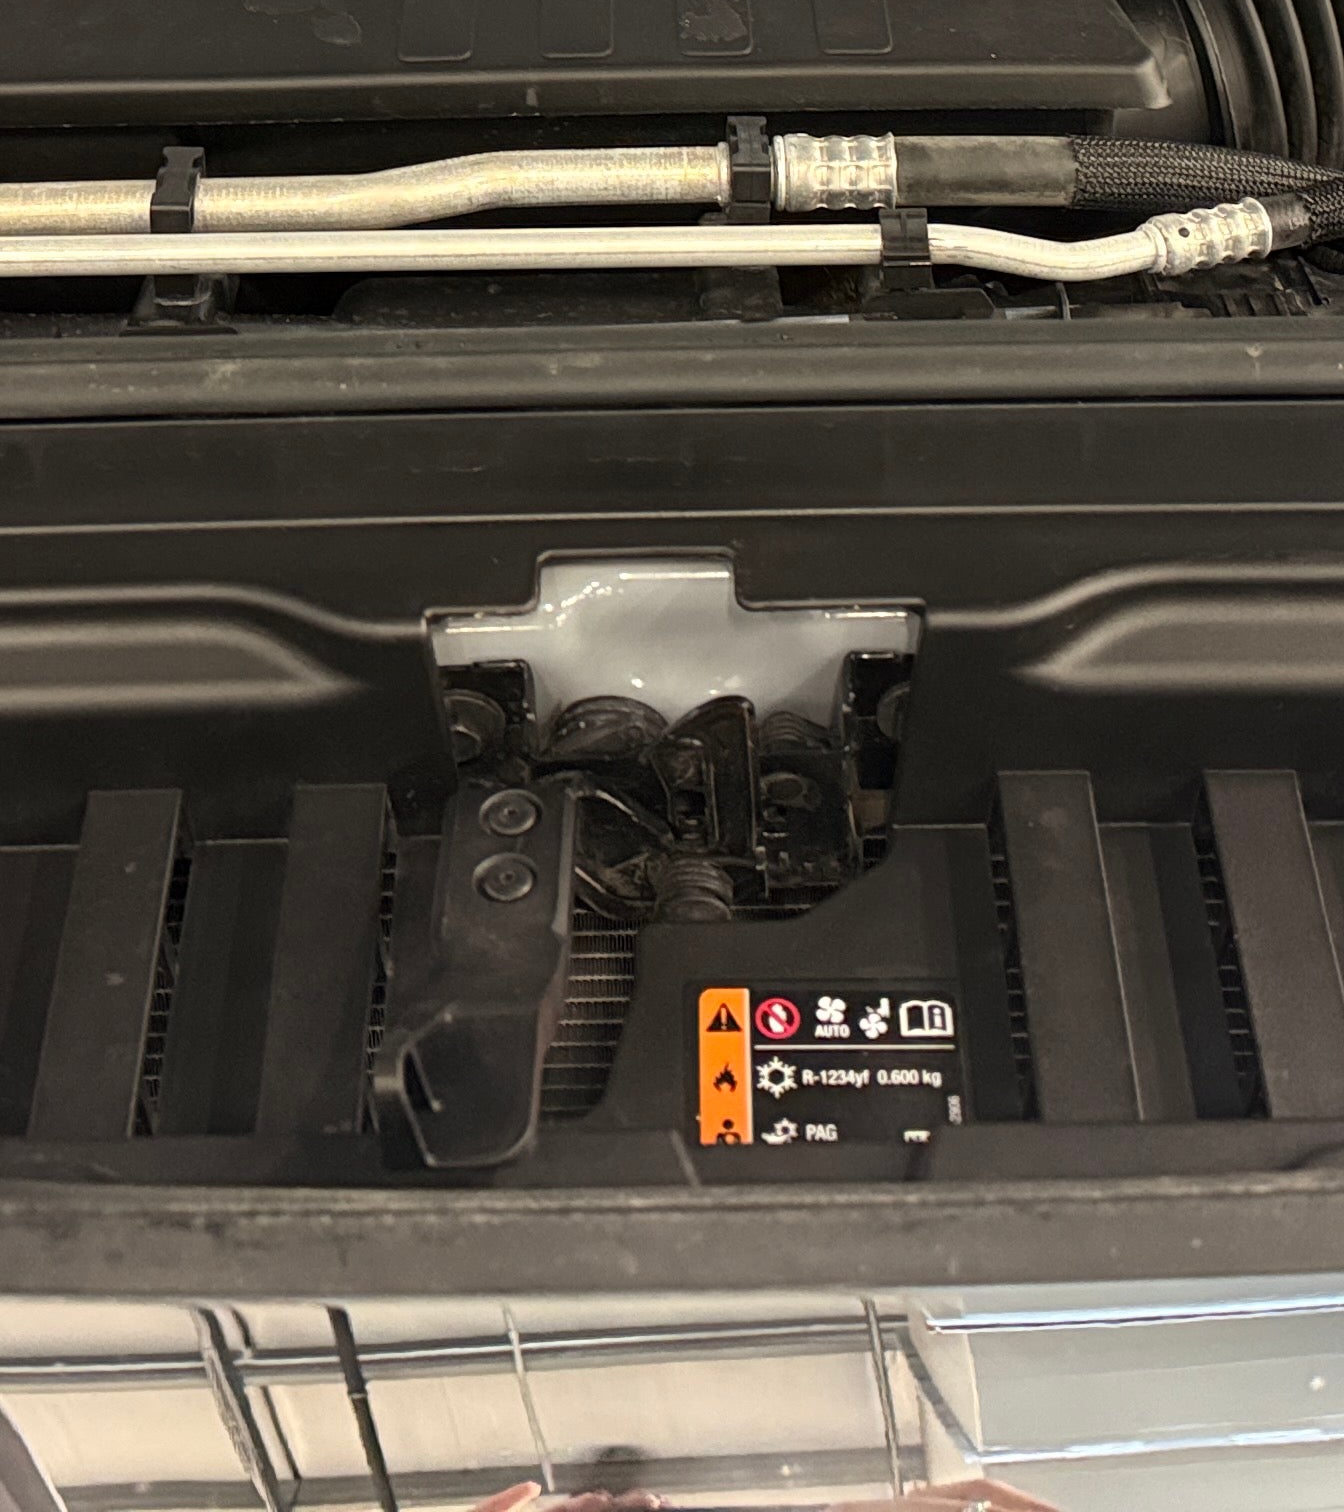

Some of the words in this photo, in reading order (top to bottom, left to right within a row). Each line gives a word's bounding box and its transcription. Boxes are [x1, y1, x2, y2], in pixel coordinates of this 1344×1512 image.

[815, 1024, 850, 1038] AUTO
[802, 1069, 870, 1086] R-1234yf
[877, 1069, 918, 1085] 0.600
[922, 1069, 942, 1088] kg
[806, 1124, 838, 1141] PAG
